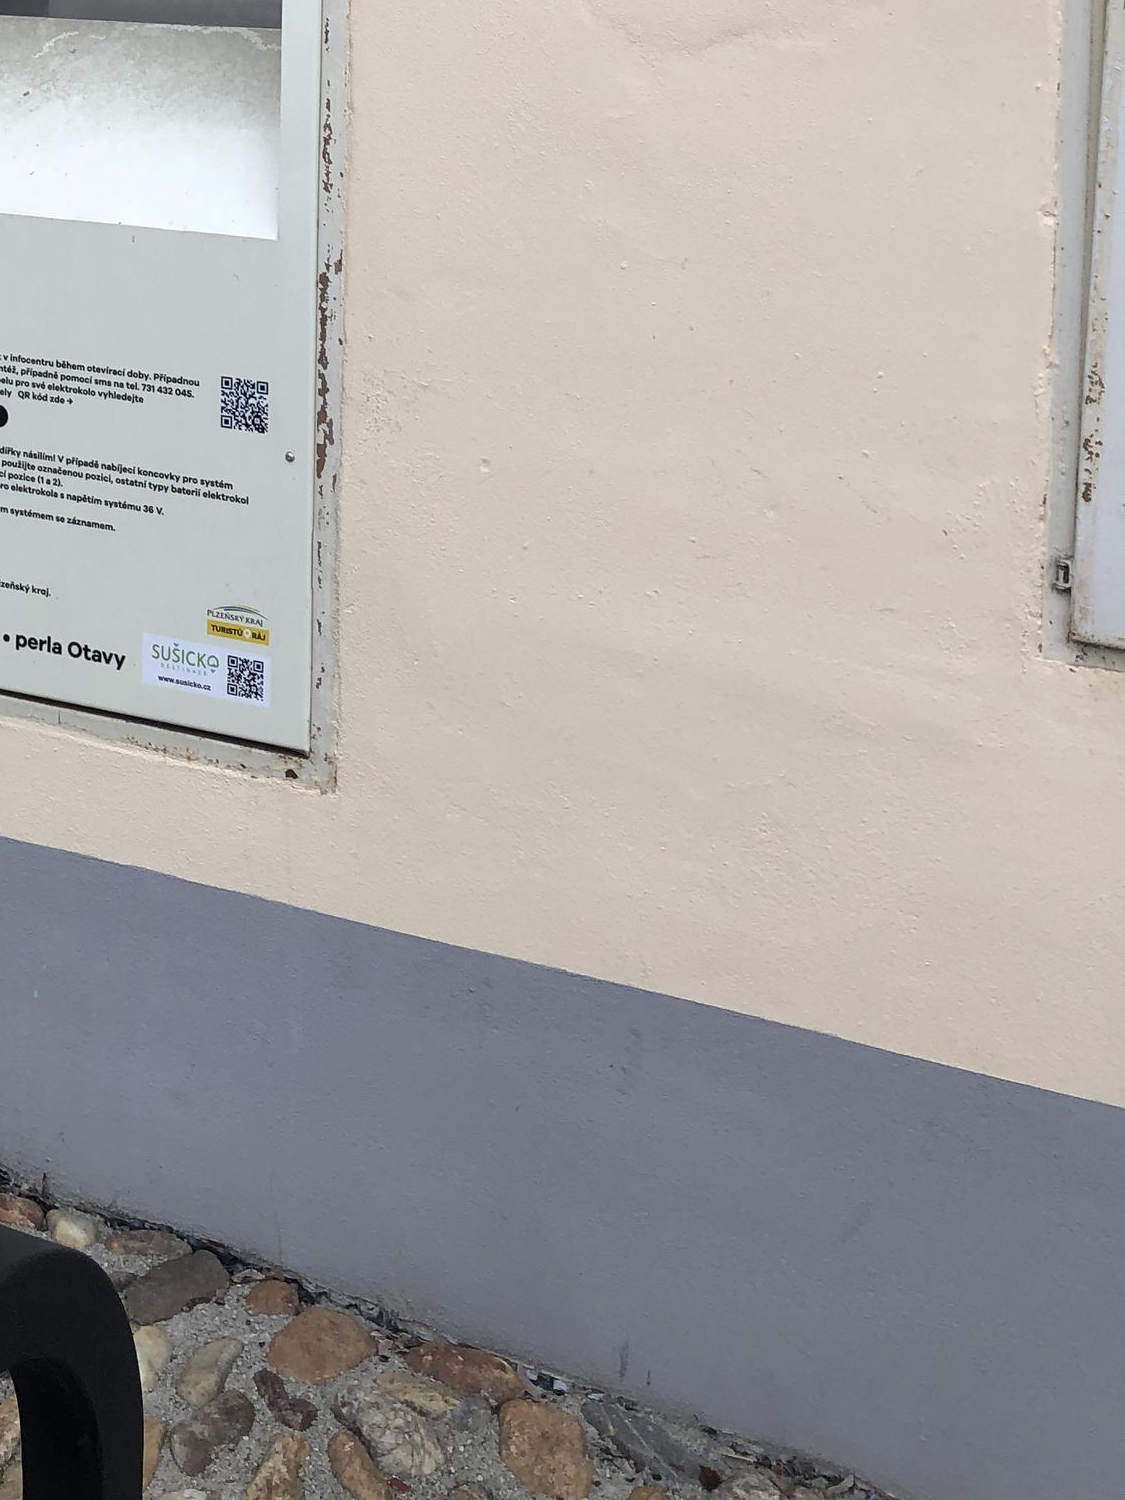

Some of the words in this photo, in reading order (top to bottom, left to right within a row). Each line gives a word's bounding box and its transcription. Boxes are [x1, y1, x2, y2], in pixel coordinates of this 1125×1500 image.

[9, 354, 54, 367] infocentru
[55, 360, 85, 371] během
[86, 364, 125, 377] otevírací
[126, 369, 151, 382] doby.
[152, 372, 200, 386] Případnou
[20, 367, 58, 379] případně
[59, 374, 92, 384] pomocí
[93, 378, 112, 386] sms
[113, 380, 124, 388] na
[125, 380, 140, 390] tel.
[140, 382, 155, 392] 731
[156, 384, 173, 394] 432
[174, 386, 194, 397] 045.
[14, 380, 30, 389] pro
[30, 381, 46, 390] své
[46, 383, 96, 396] elektrokolo
[97, 390, 144, 404] vyhledejte
[17, 390, 30, 399] QR
[31, 392, 48, 402] kód
[49, 395, 65, 404] zde
[7, 473, 36, 482] pozice
[22, 450, 55, 462] násilím!
[65, 456, 99, 469] případě
[100, 463, 136, 475] nabíjecí
[137, 467, 181, 483] koncovky
[182, 475, 198, 484] pro
[199, 478, 233, 488] systém
[1, 461, 36, 473] použijte
[36, 466, 83, 479] označenou
[84, 473, 113, 485] pozici,
[114, 478, 147, 488] ostatní
[147, 481, 169, 494] typy
[170, 484, 201, 497] baterií
[202, 490, 249, 504] elektrokol
[10, 483, 58, 498] elektrokola
[66, 493, 102, 504] napětím
[103, 499, 141, 510] systému
[142, 503, 154, 512] 36
[155, 505, 164, 514] V.
[9, 508, 54, 521] systémem
[55, 515, 65, 523] se
[66, 515, 115, 531] záznamem.
[31, 584, 51, 597] kraj.
[206, 609, 244, 623] PLZEŇSKÝ
[244, 617, 264, 627] KRAJ
[211, 624, 243, 637] TURISTŮ
[251, 631, 266, 641] RÁJ
[15, 633, 62, 654] perla
[67, 638, 126, 671] Otavy
[151, 643, 220, 669] SUŠICKO
[157, 674, 212, 692] www.susicko.cz
